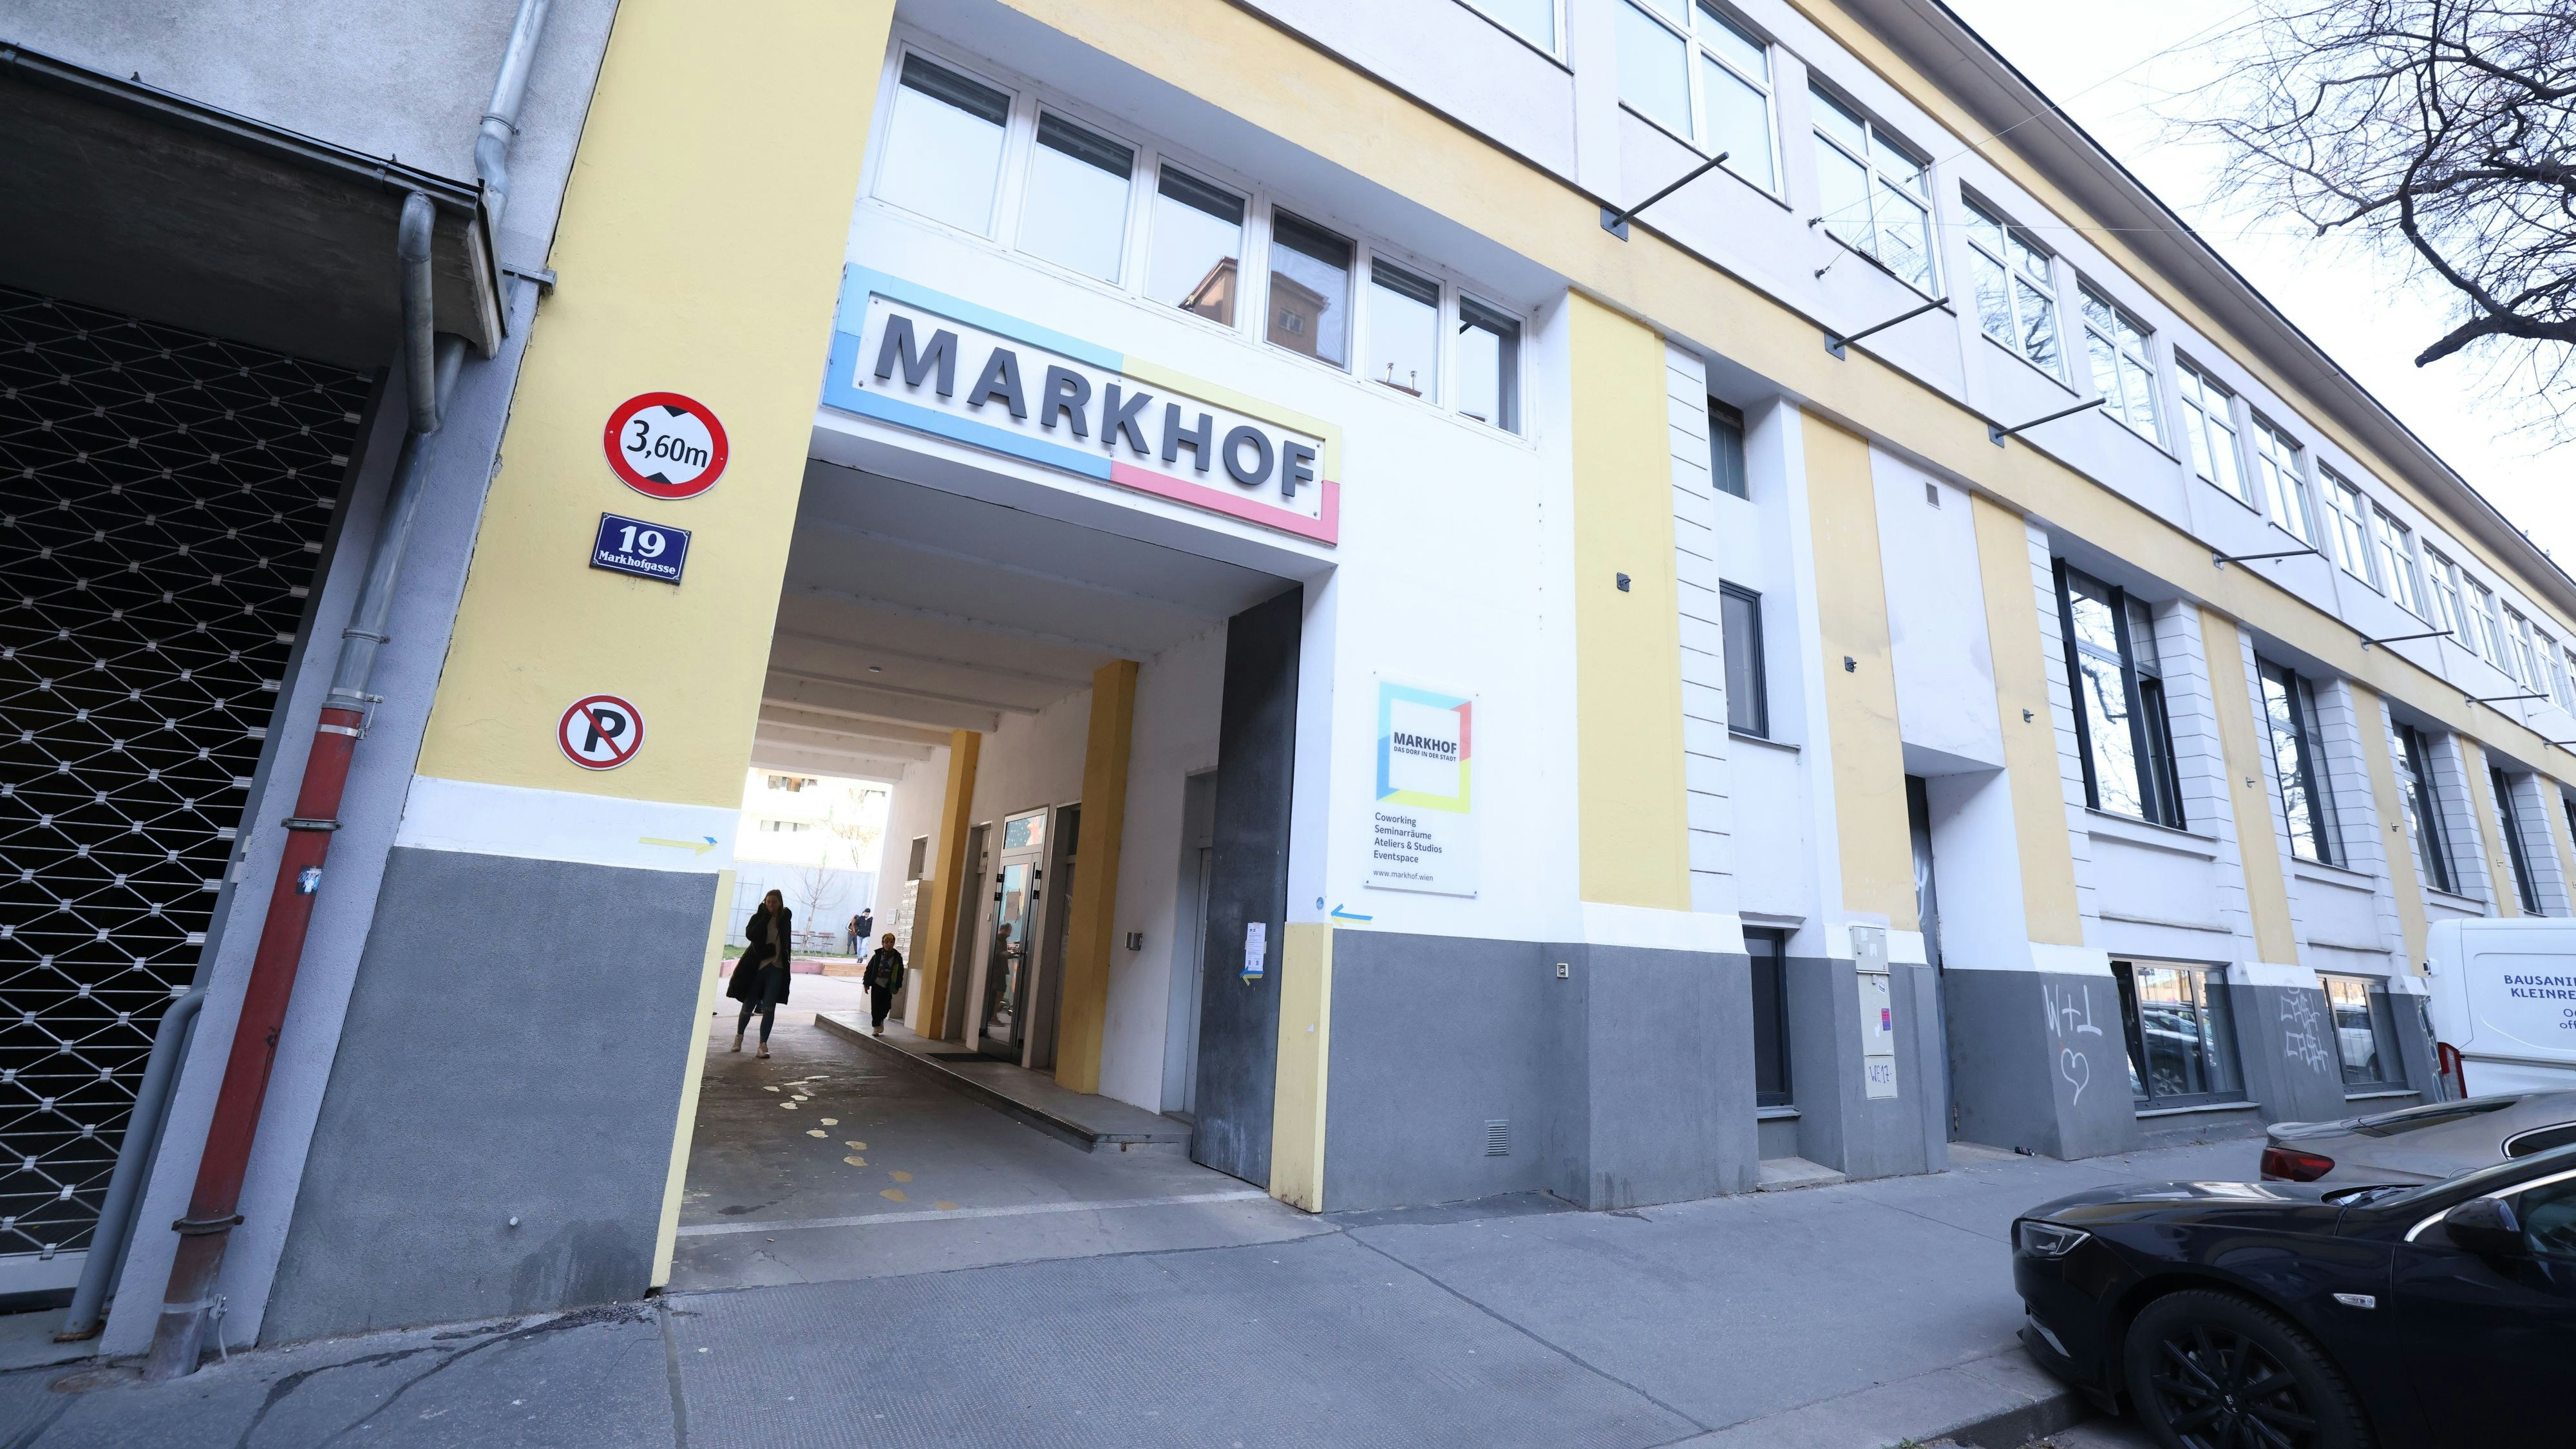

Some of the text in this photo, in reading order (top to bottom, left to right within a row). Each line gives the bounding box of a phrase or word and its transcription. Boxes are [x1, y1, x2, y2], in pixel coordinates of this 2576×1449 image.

[874, 314, 1315, 497] MARKHOF
[627, 419, 707, 468] 3,60m
[619, 526, 666, 558] 19
[598, 550, 676, 574] Markhofgasse
[583, 708, 626, 752] P
[1394, 732, 1457, 754] MARKHOF
[1375, 812, 1416, 828] Coworking
[1374, 824, 1432, 840] Seminarräume
[1374, 837, 1442, 853] Ateliers & Studios
[1374, 849, 1419, 863] Eventspace
[1373, 869, 1434, 882] www.markhof.wien
[2510, 987, 2576, 999] KLEINRE
